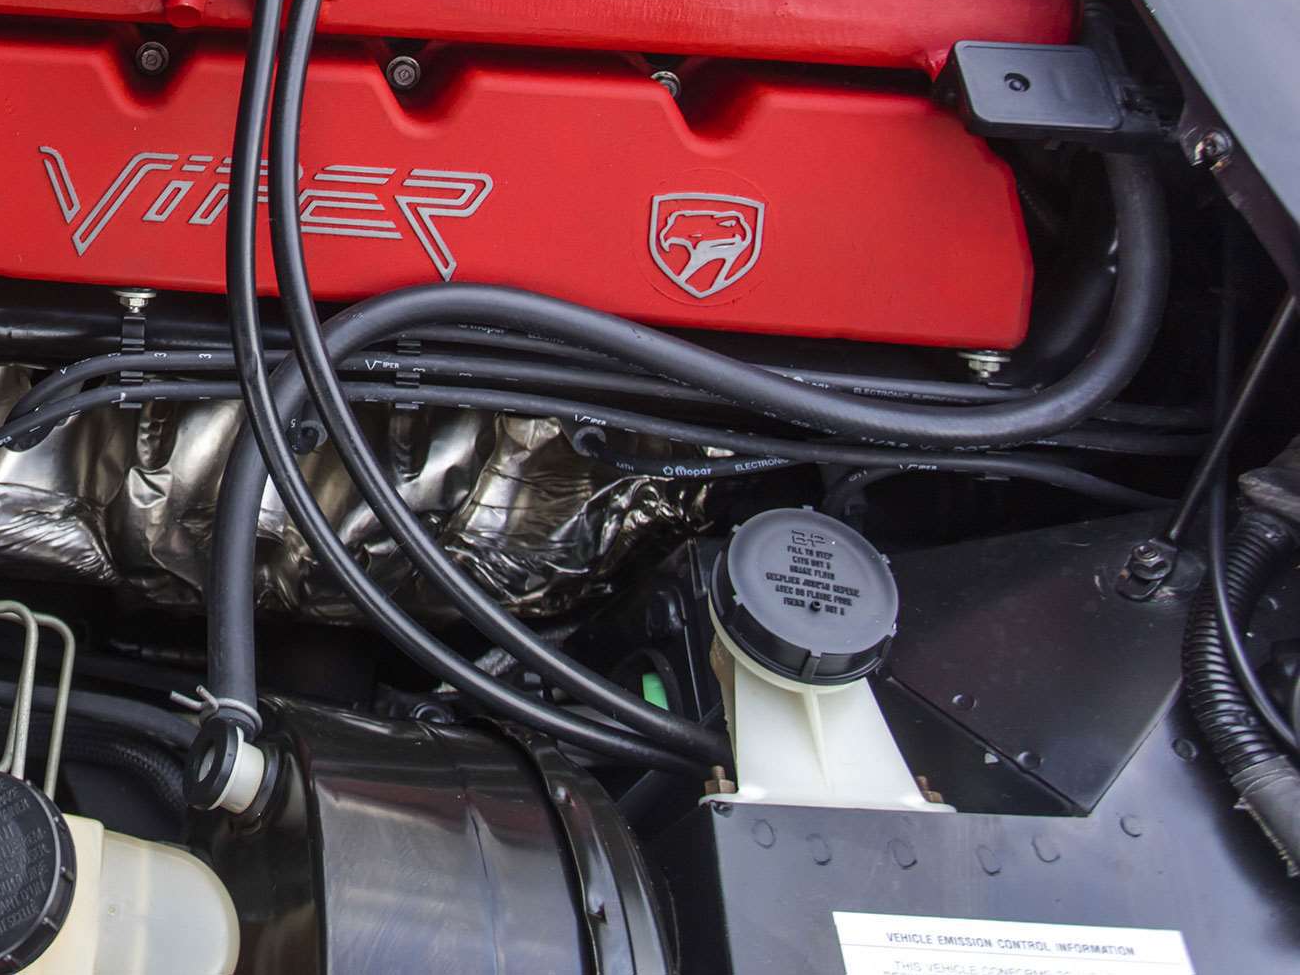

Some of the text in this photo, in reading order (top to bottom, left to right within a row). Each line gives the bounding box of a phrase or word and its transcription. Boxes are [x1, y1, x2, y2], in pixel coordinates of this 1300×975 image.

[674, 464, 712, 477] Mopar
[886, 931, 1135, 956] VEHICLE EMISSION CONTROL INFORMATION
